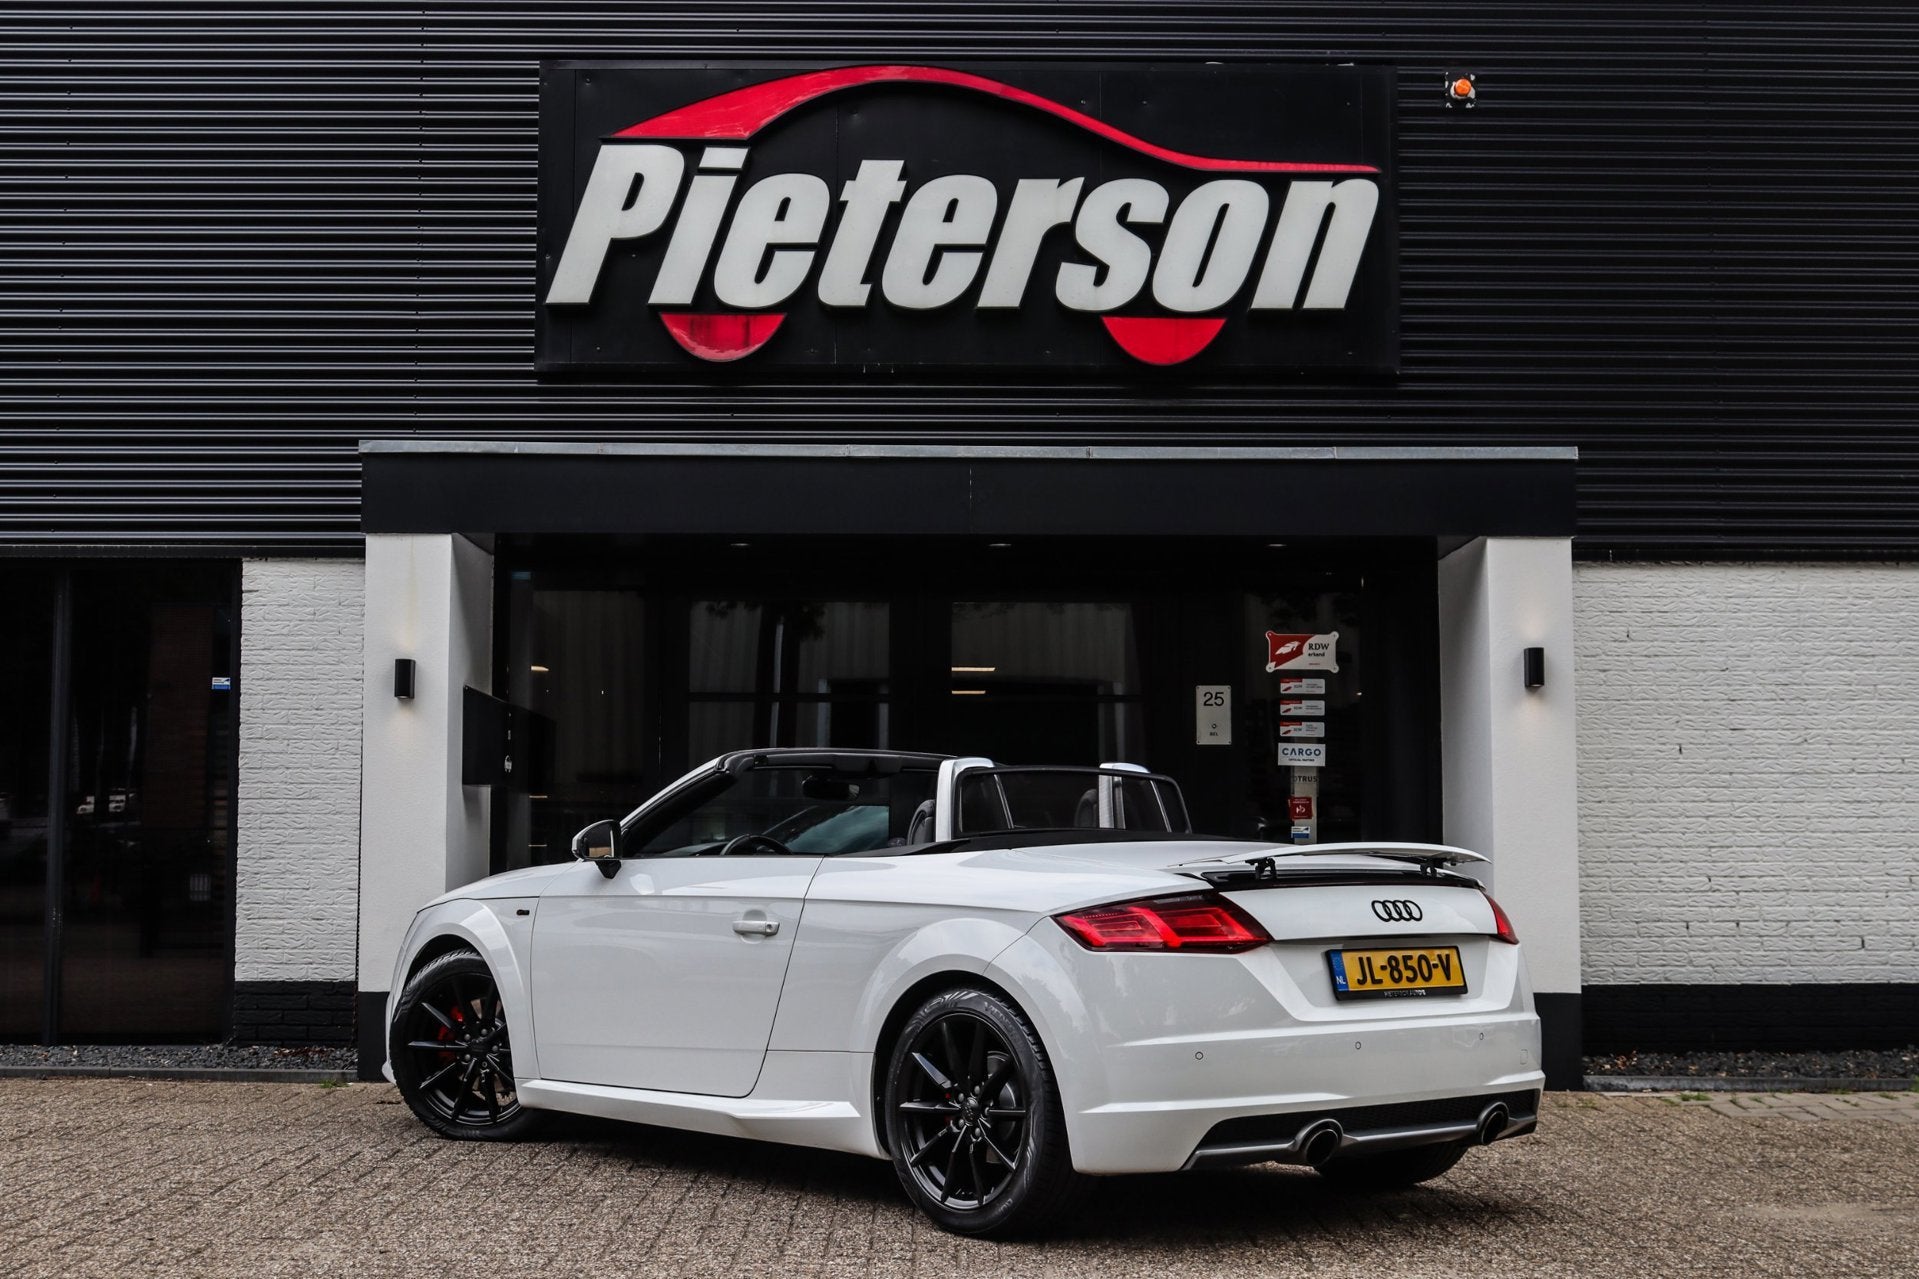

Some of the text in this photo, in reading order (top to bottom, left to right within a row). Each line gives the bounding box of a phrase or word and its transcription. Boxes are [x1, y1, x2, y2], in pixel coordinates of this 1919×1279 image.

[545, 144, 1380, 311] Pieterson
[1308, 642, 1330, 651] RDW
[1203, 691, 1225, 707] 25
[1281, 747, 1322, 757] CARGO
[1357, 953, 1452, 986] JL-850-V
[1335, 975, 1347, 985] NL
